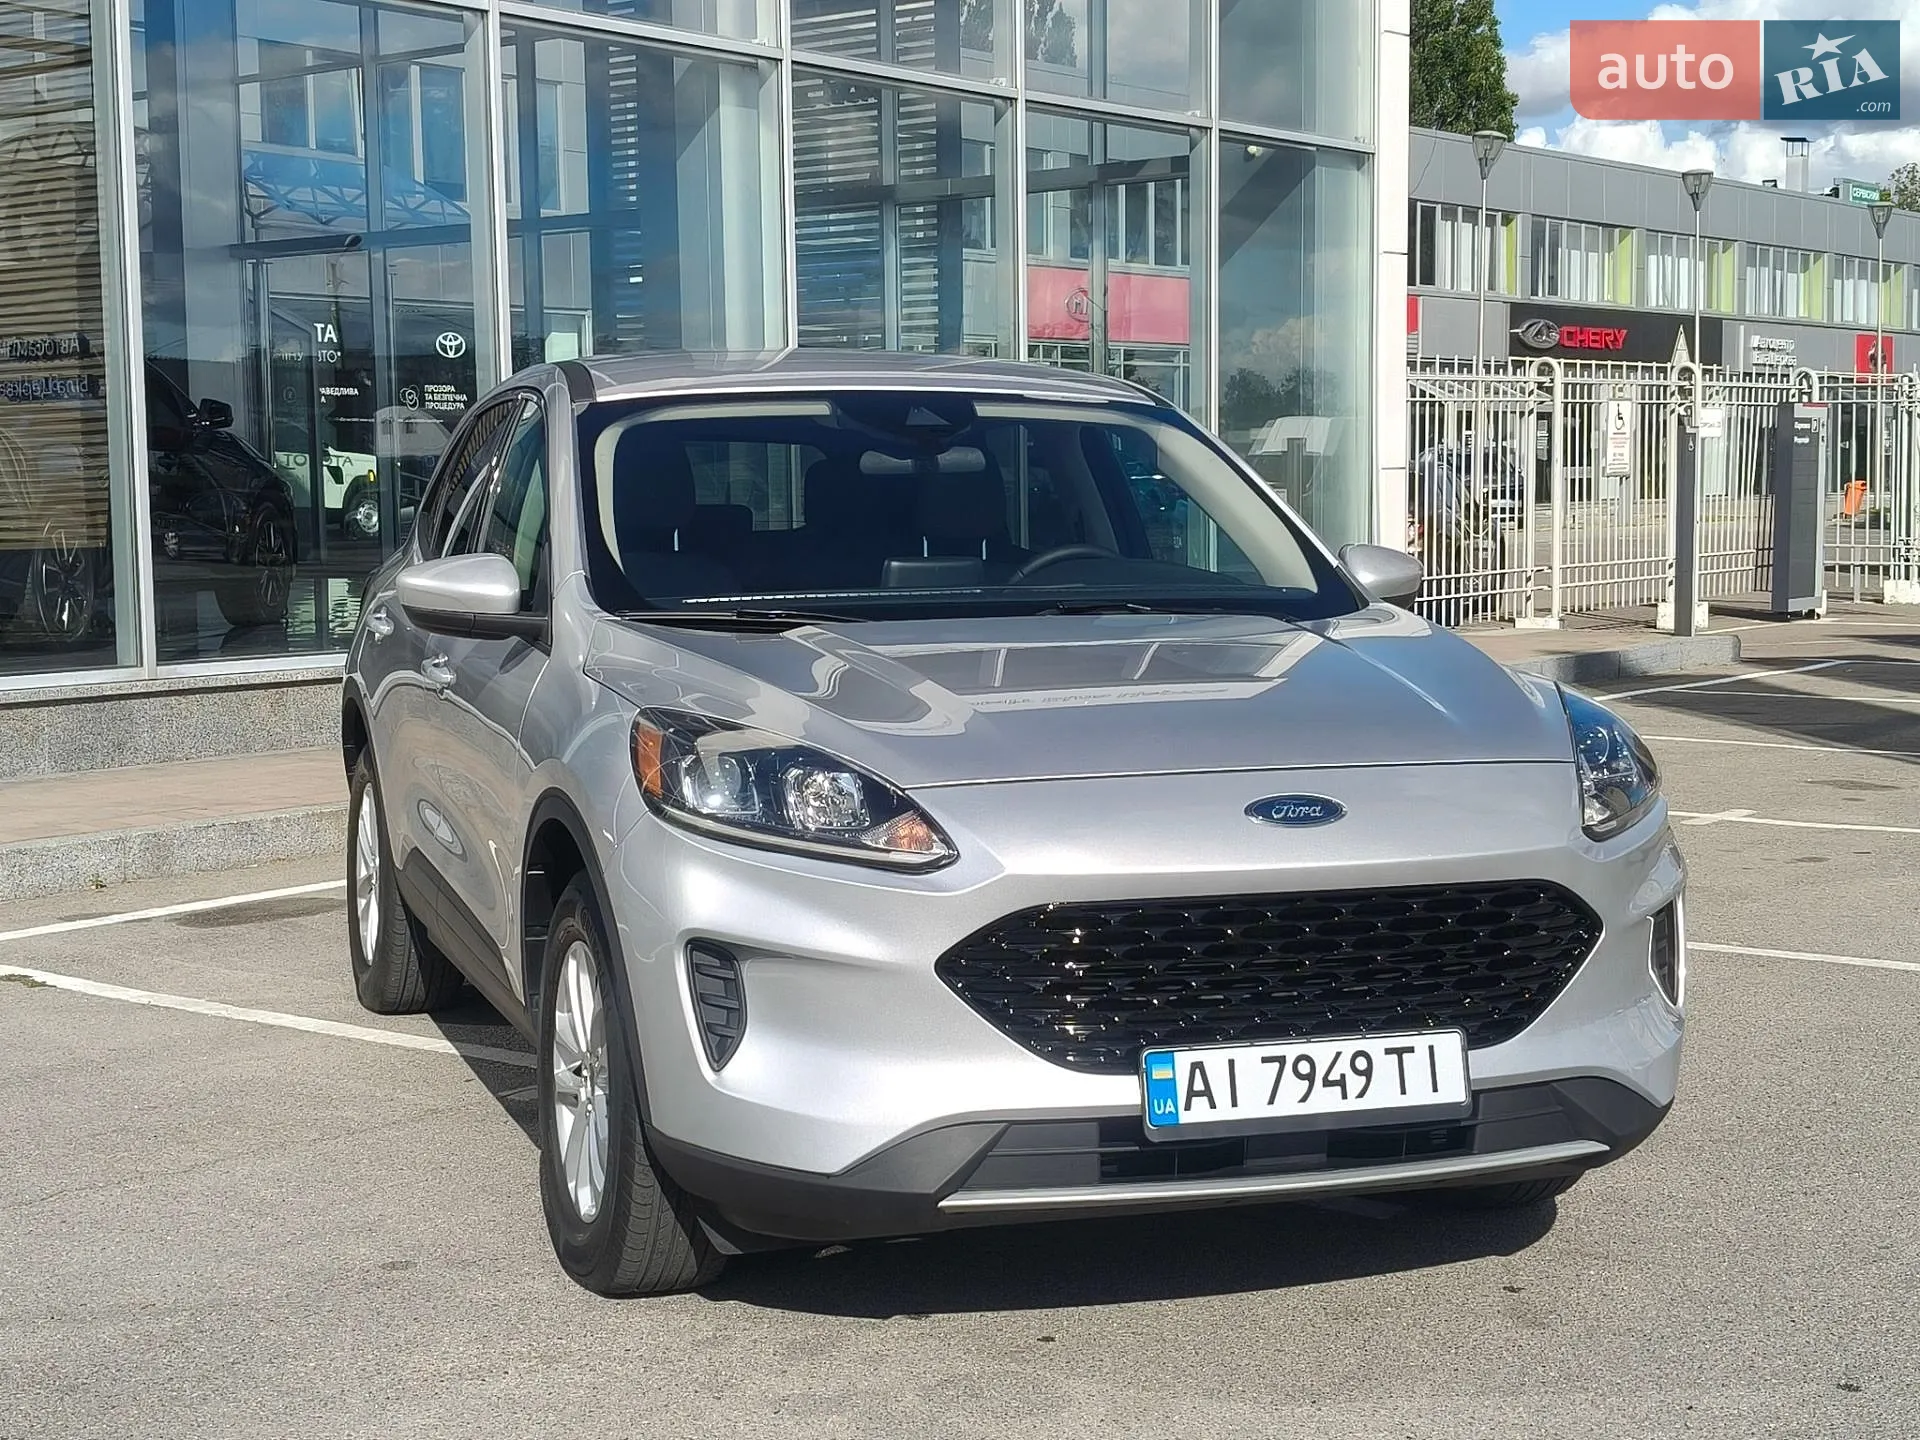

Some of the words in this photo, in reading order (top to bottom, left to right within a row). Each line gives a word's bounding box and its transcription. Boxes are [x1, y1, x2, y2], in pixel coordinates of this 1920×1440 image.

[1559, 325, 1628, 350] CHERY
[424, 384, 456, 393] ПРОЗОРА
[424, 393, 433, 401] ТА
[433, 393, 468, 402] БЕЗПЕЧНА
[425, 401, 465, 411] ПРОЦЕДУРА
[1271, 802, 1324, 819] Ford
[1183, 1057, 1239, 1112] AI
[1261, 1049, 1374, 1106] 7949
[1384, 1044, 1439, 1096] TI
[1153, 1098, 1177, 1116] UA
